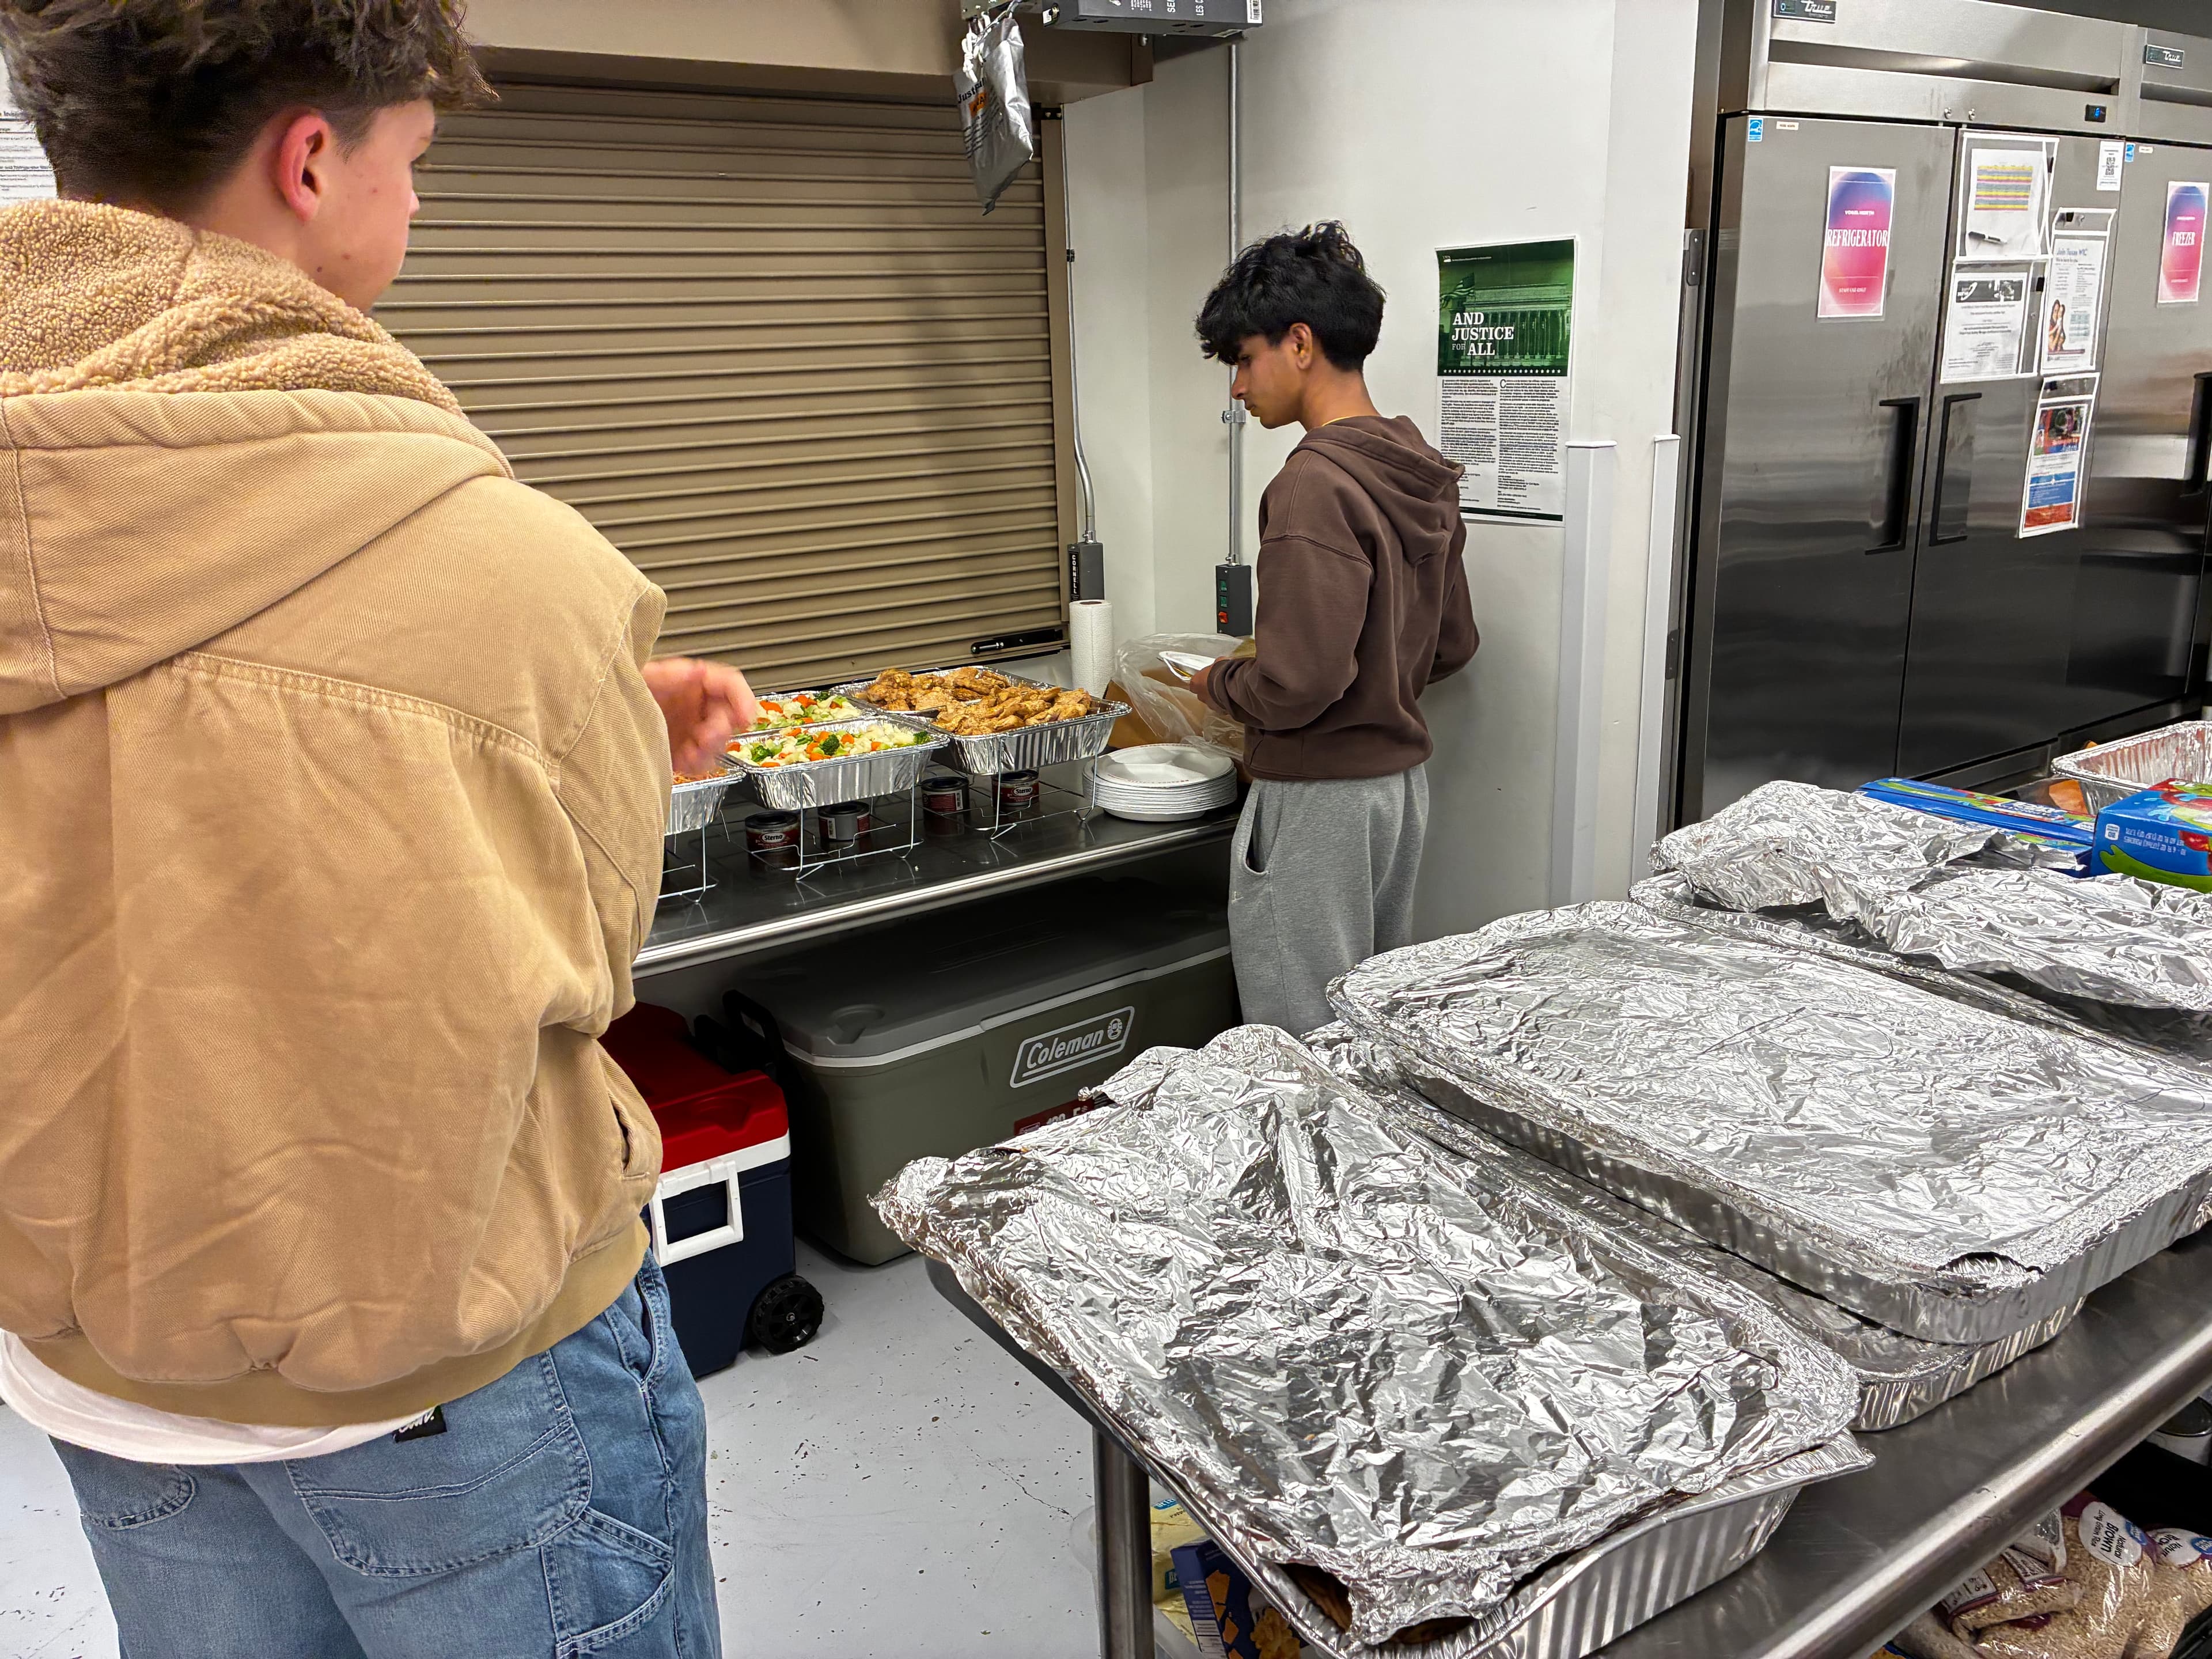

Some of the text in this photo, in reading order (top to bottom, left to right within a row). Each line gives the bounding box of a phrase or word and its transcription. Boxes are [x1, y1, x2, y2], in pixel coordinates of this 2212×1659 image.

[1827, 229, 1888, 247] REFRIGERATOR
[1452, 312, 1484, 325] AND
[1452, 326, 1514, 341] JUSTICE
[1467, 342, 1495, 355] ALL
[1027, 1029, 1104, 1069] Coleman
[2100, 1521, 2119, 1552] Brown
[2114, 1535, 2127, 1559] Natural
